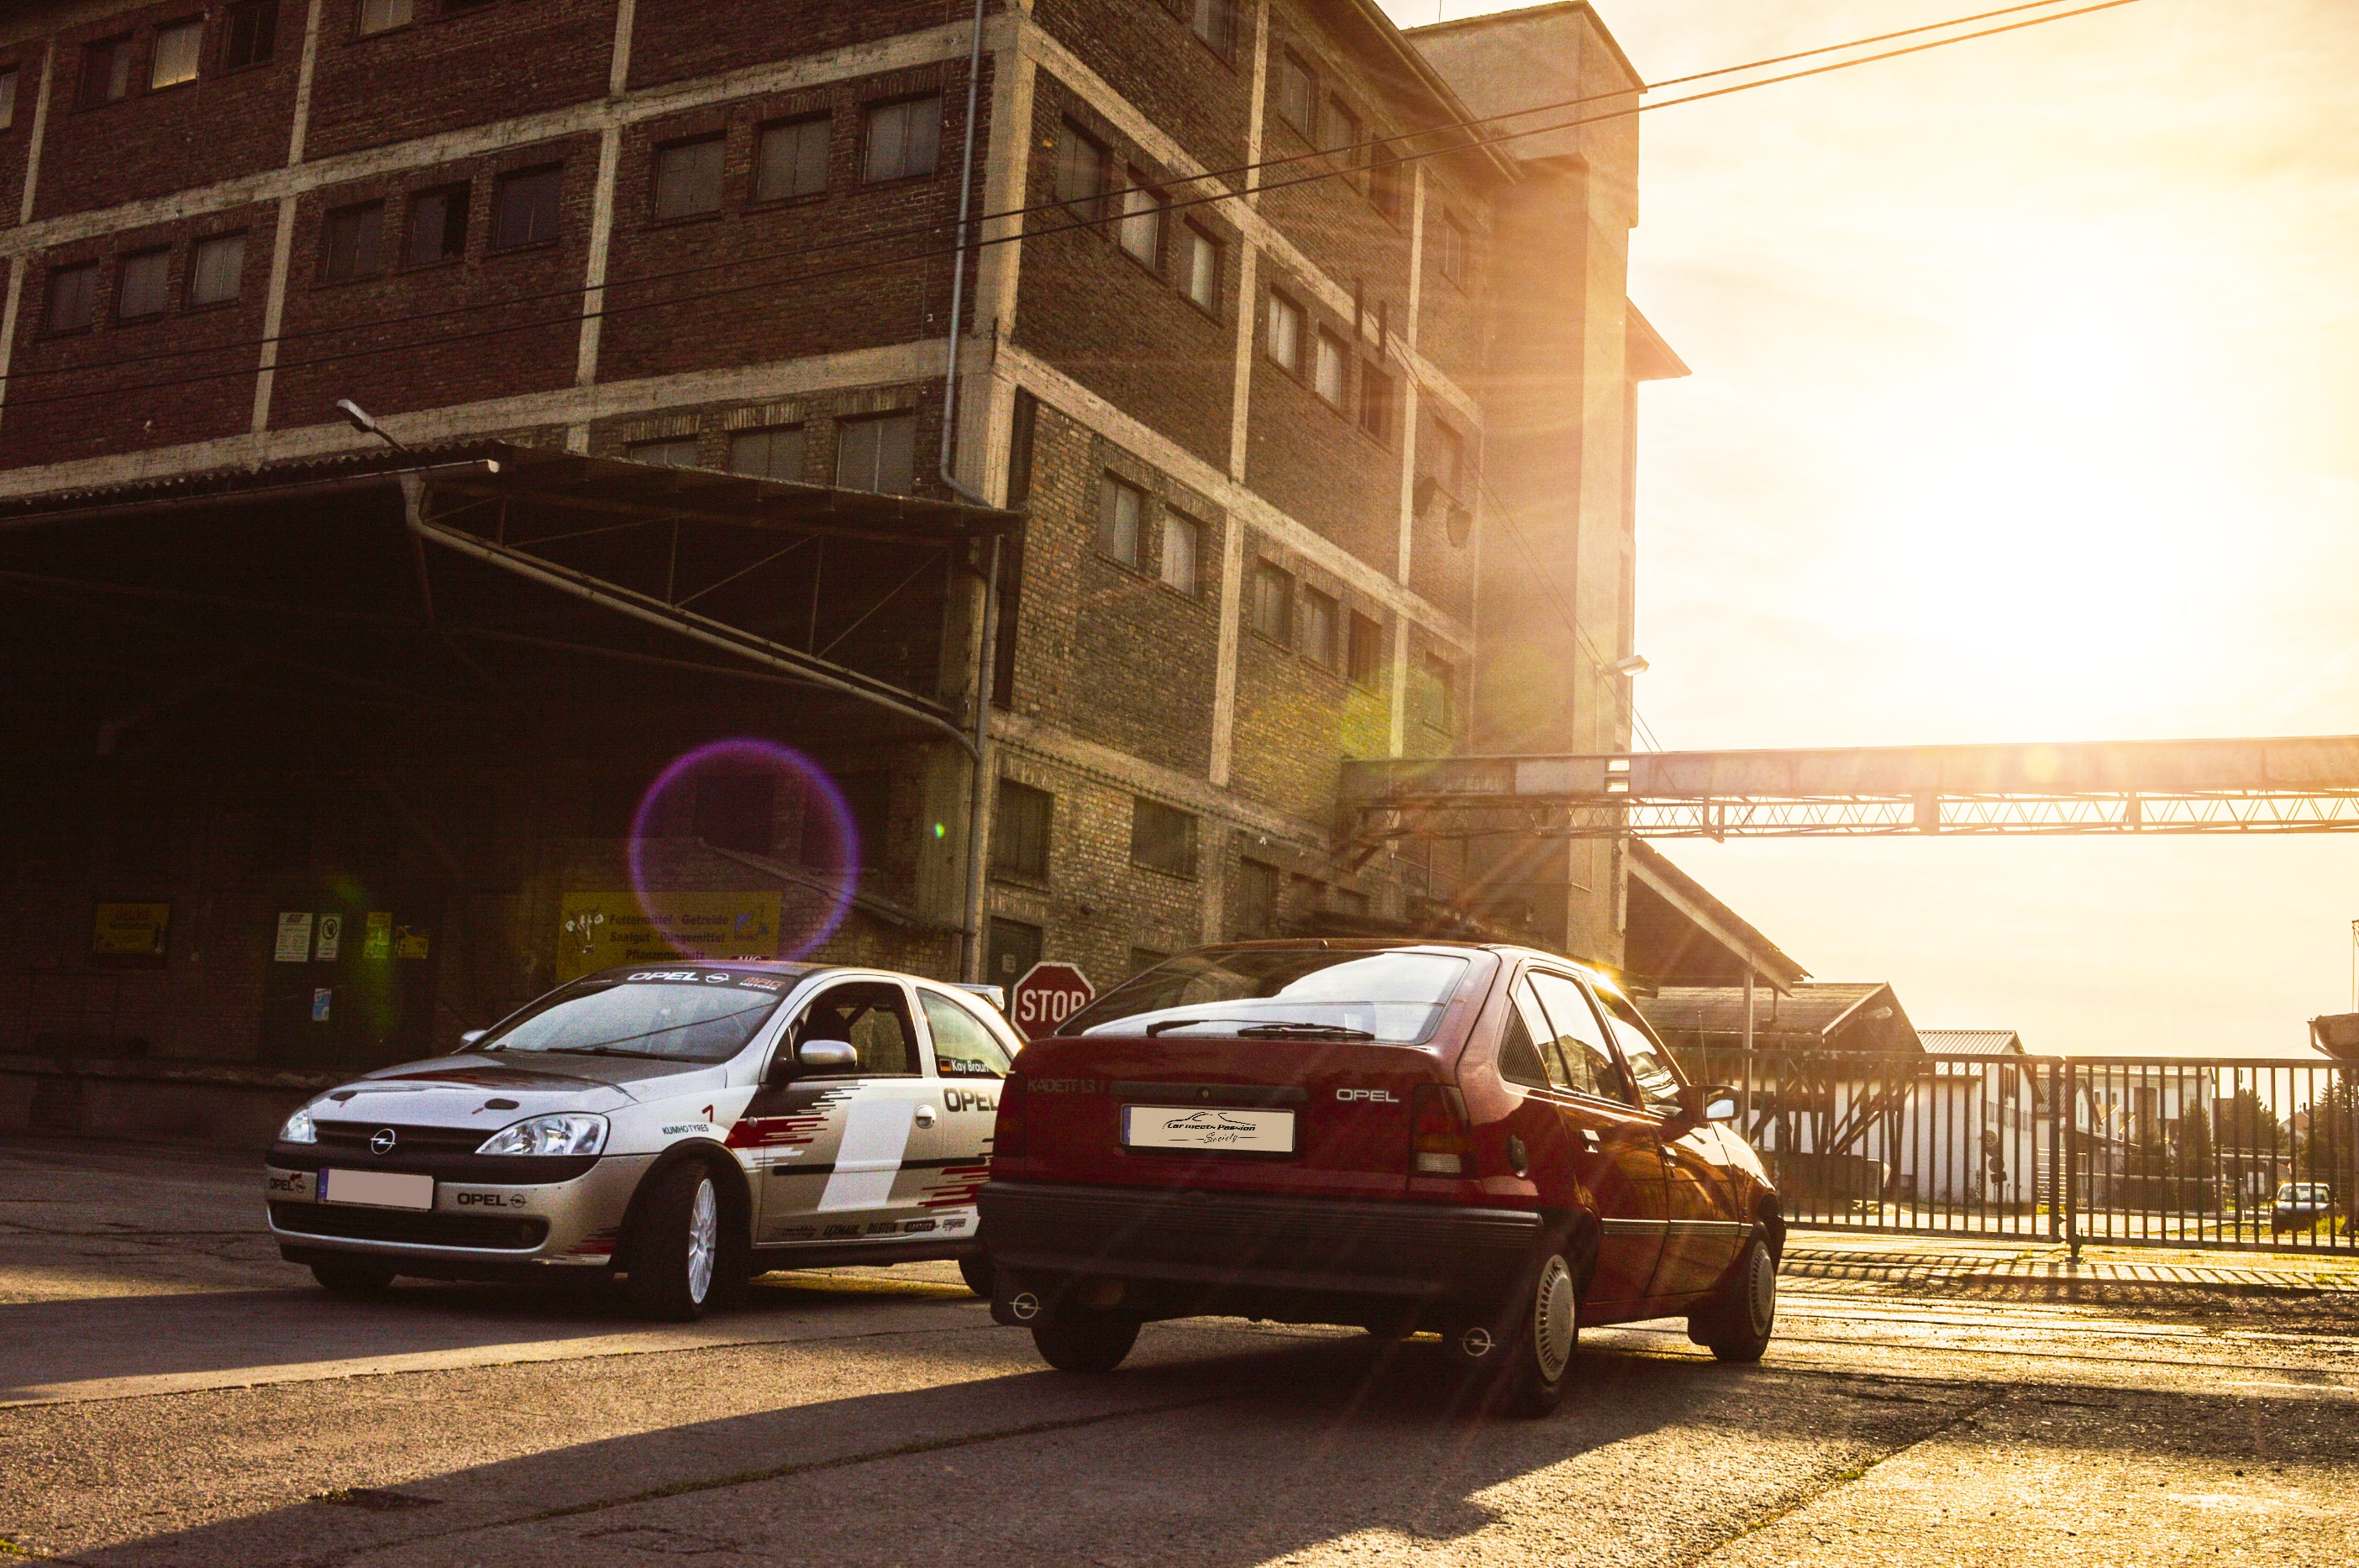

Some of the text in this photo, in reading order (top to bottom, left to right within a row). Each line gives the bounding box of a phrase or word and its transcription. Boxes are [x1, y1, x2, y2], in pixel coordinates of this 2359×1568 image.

[681, 914, 729, 925] Getreide
[627, 972, 699, 981] OPEL
[738, 982, 778, 991] MOTORS
[1020, 989, 1085, 1023] STOP
[951, 1059, 990, 1074] Kay Braun
[1027, 1078, 1078, 1093] KADETT
[943, 1088, 999, 1112] OPEL
[1336, 1088, 1400, 1103] OPEL
[662, 1124, 709, 1135] KUMHO TYRES
[269, 1178, 294, 1191] OPEL
[457, 1193, 508, 1207] OPEL
